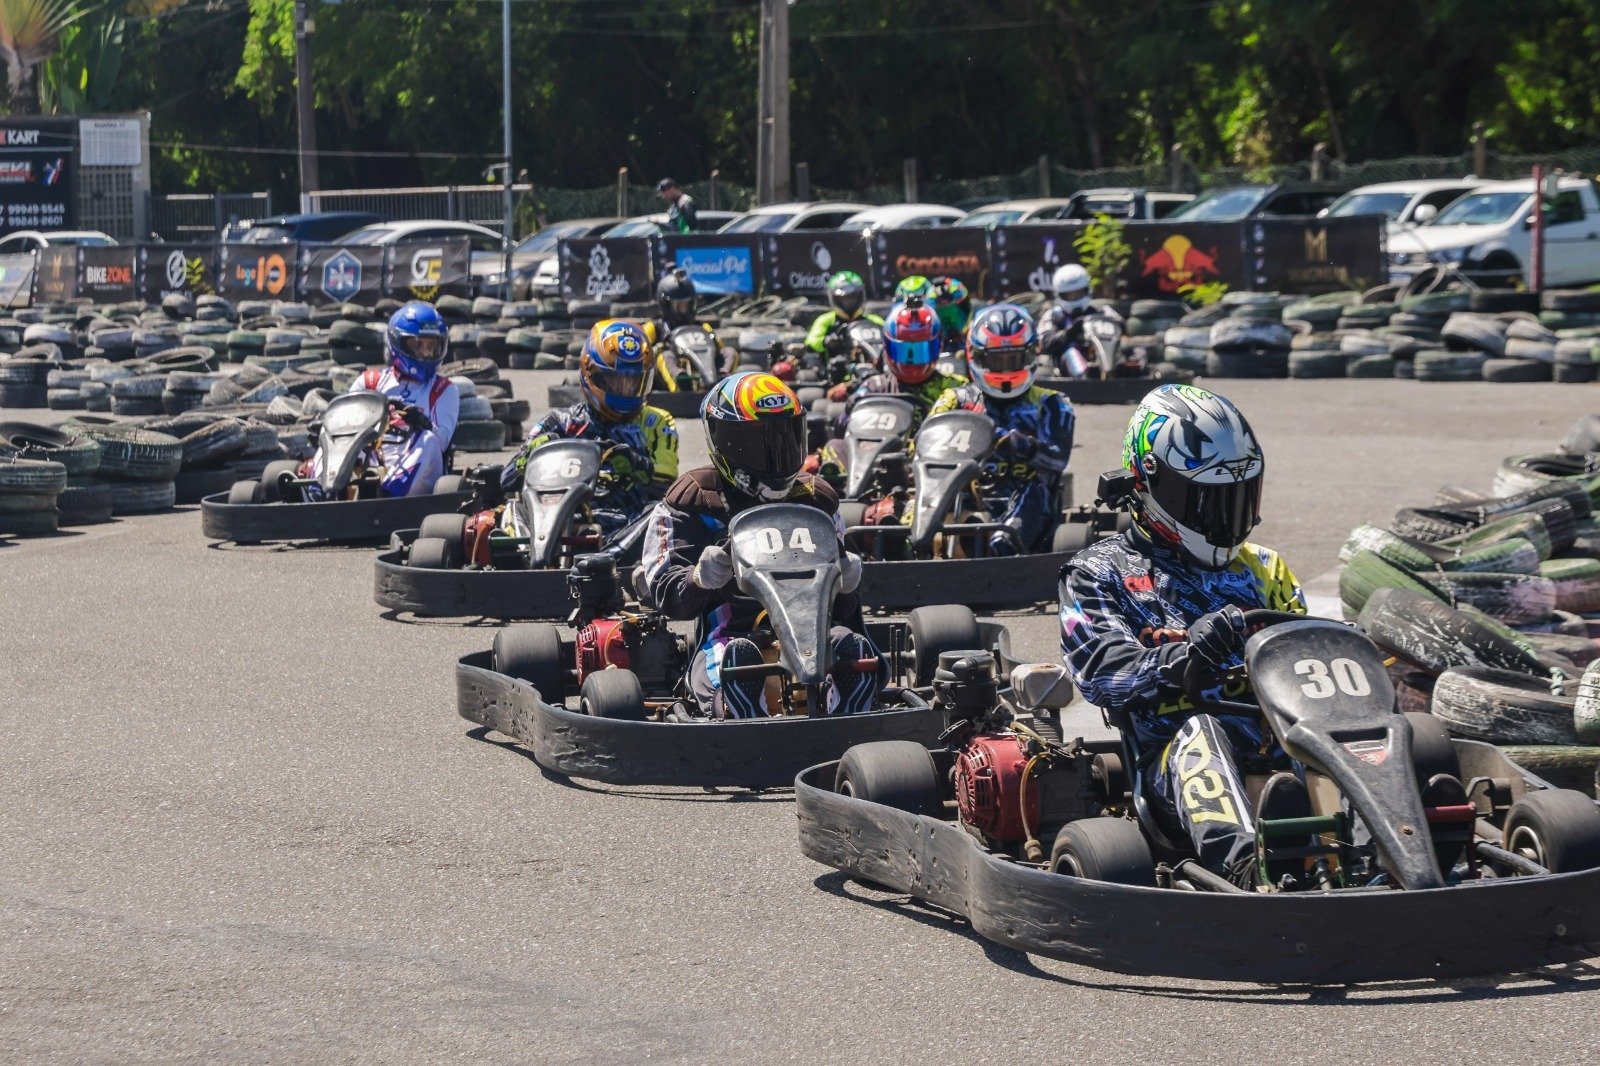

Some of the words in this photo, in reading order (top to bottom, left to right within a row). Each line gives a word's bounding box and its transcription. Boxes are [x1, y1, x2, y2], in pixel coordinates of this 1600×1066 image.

[7, 130, 40, 145] KART
[860, 413, 897, 430] 29
[931, 425, 972, 453] 24
[756, 527, 817, 554] 04
[1294, 657, 1372, 698] 30
